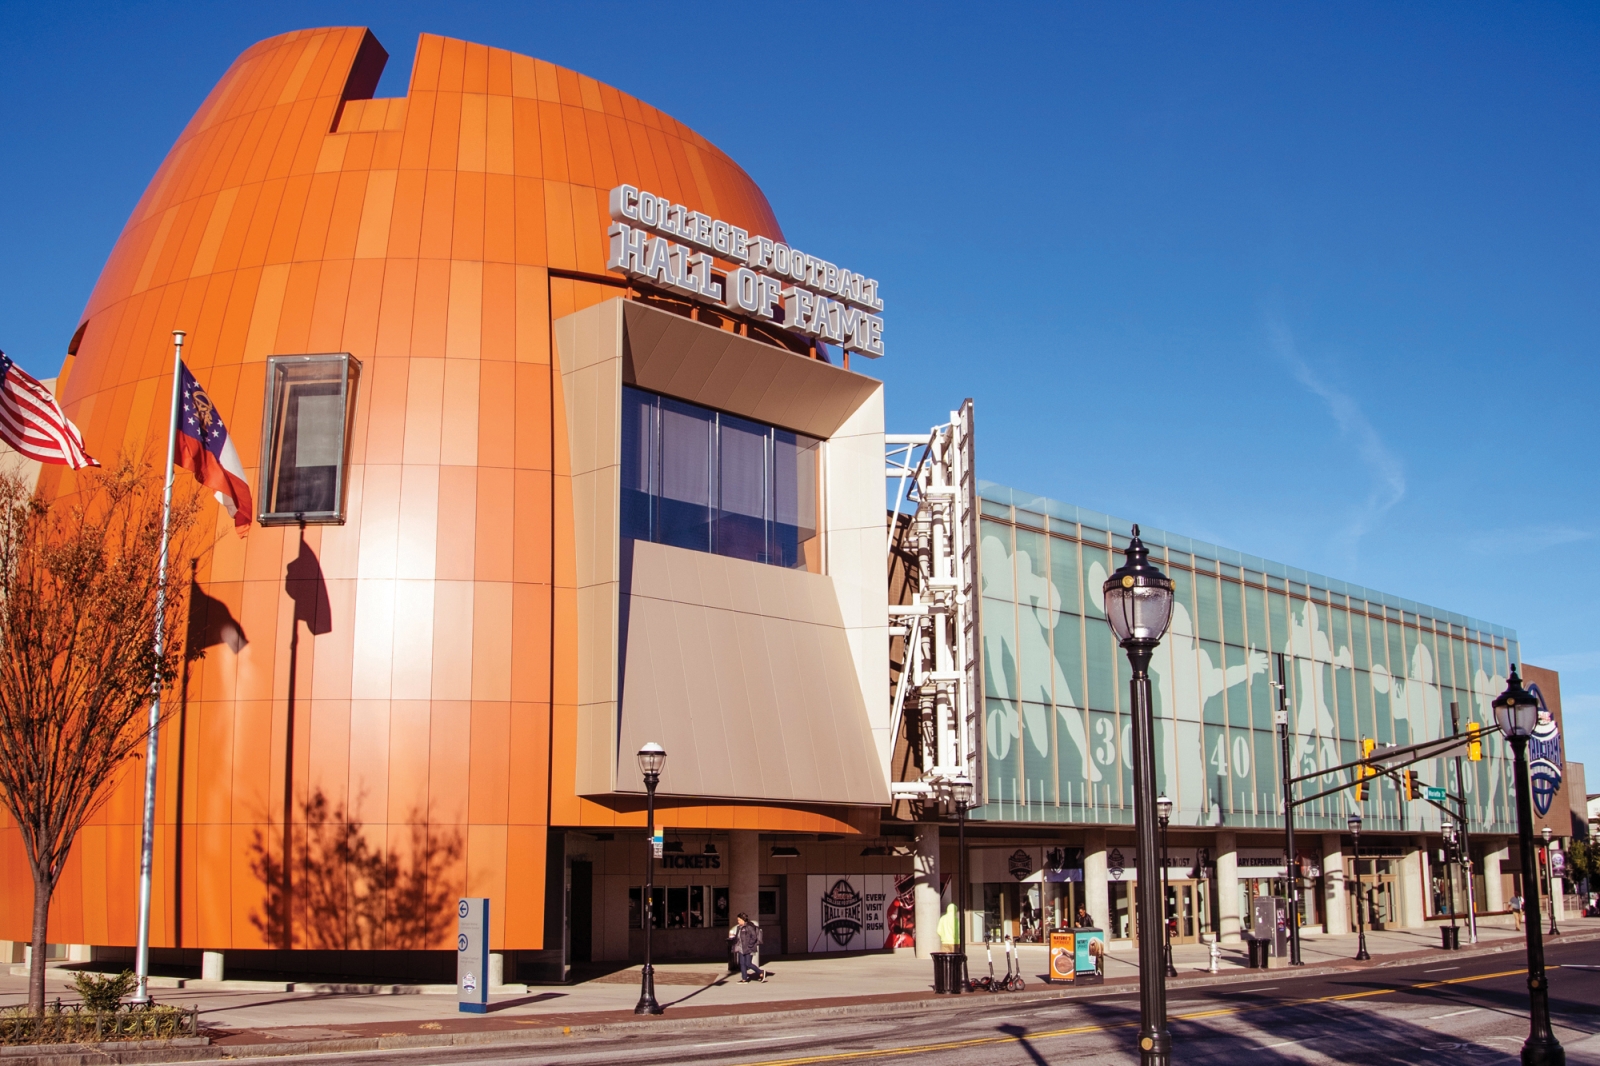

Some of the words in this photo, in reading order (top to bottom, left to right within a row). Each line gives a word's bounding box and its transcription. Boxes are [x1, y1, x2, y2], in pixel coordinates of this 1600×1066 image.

[619, 183, 749, 262] COLLEGE
[756, 234, 884, 313] FOOTBALL
[616, 223, 722, 304] HALL
[736, 266, 782, 319] OF
[793, 286, 885, 357] FAME
[1210, 733, 1250, 778] 40
[661, 855, 721, 869] TICKETS
[1250, 857, 1282, 867] EXPERIENCE
[865, 893, 887, 902] EVERY
[865, 903, 883, 911] VISIT
[824, 904, 841, 923] HALL
[844, 904, 861, 921] FAME
[866, 913, 873, 921] IS
[873, 913, 879, 921] A
[866, 923, 884, 931] RUSH
